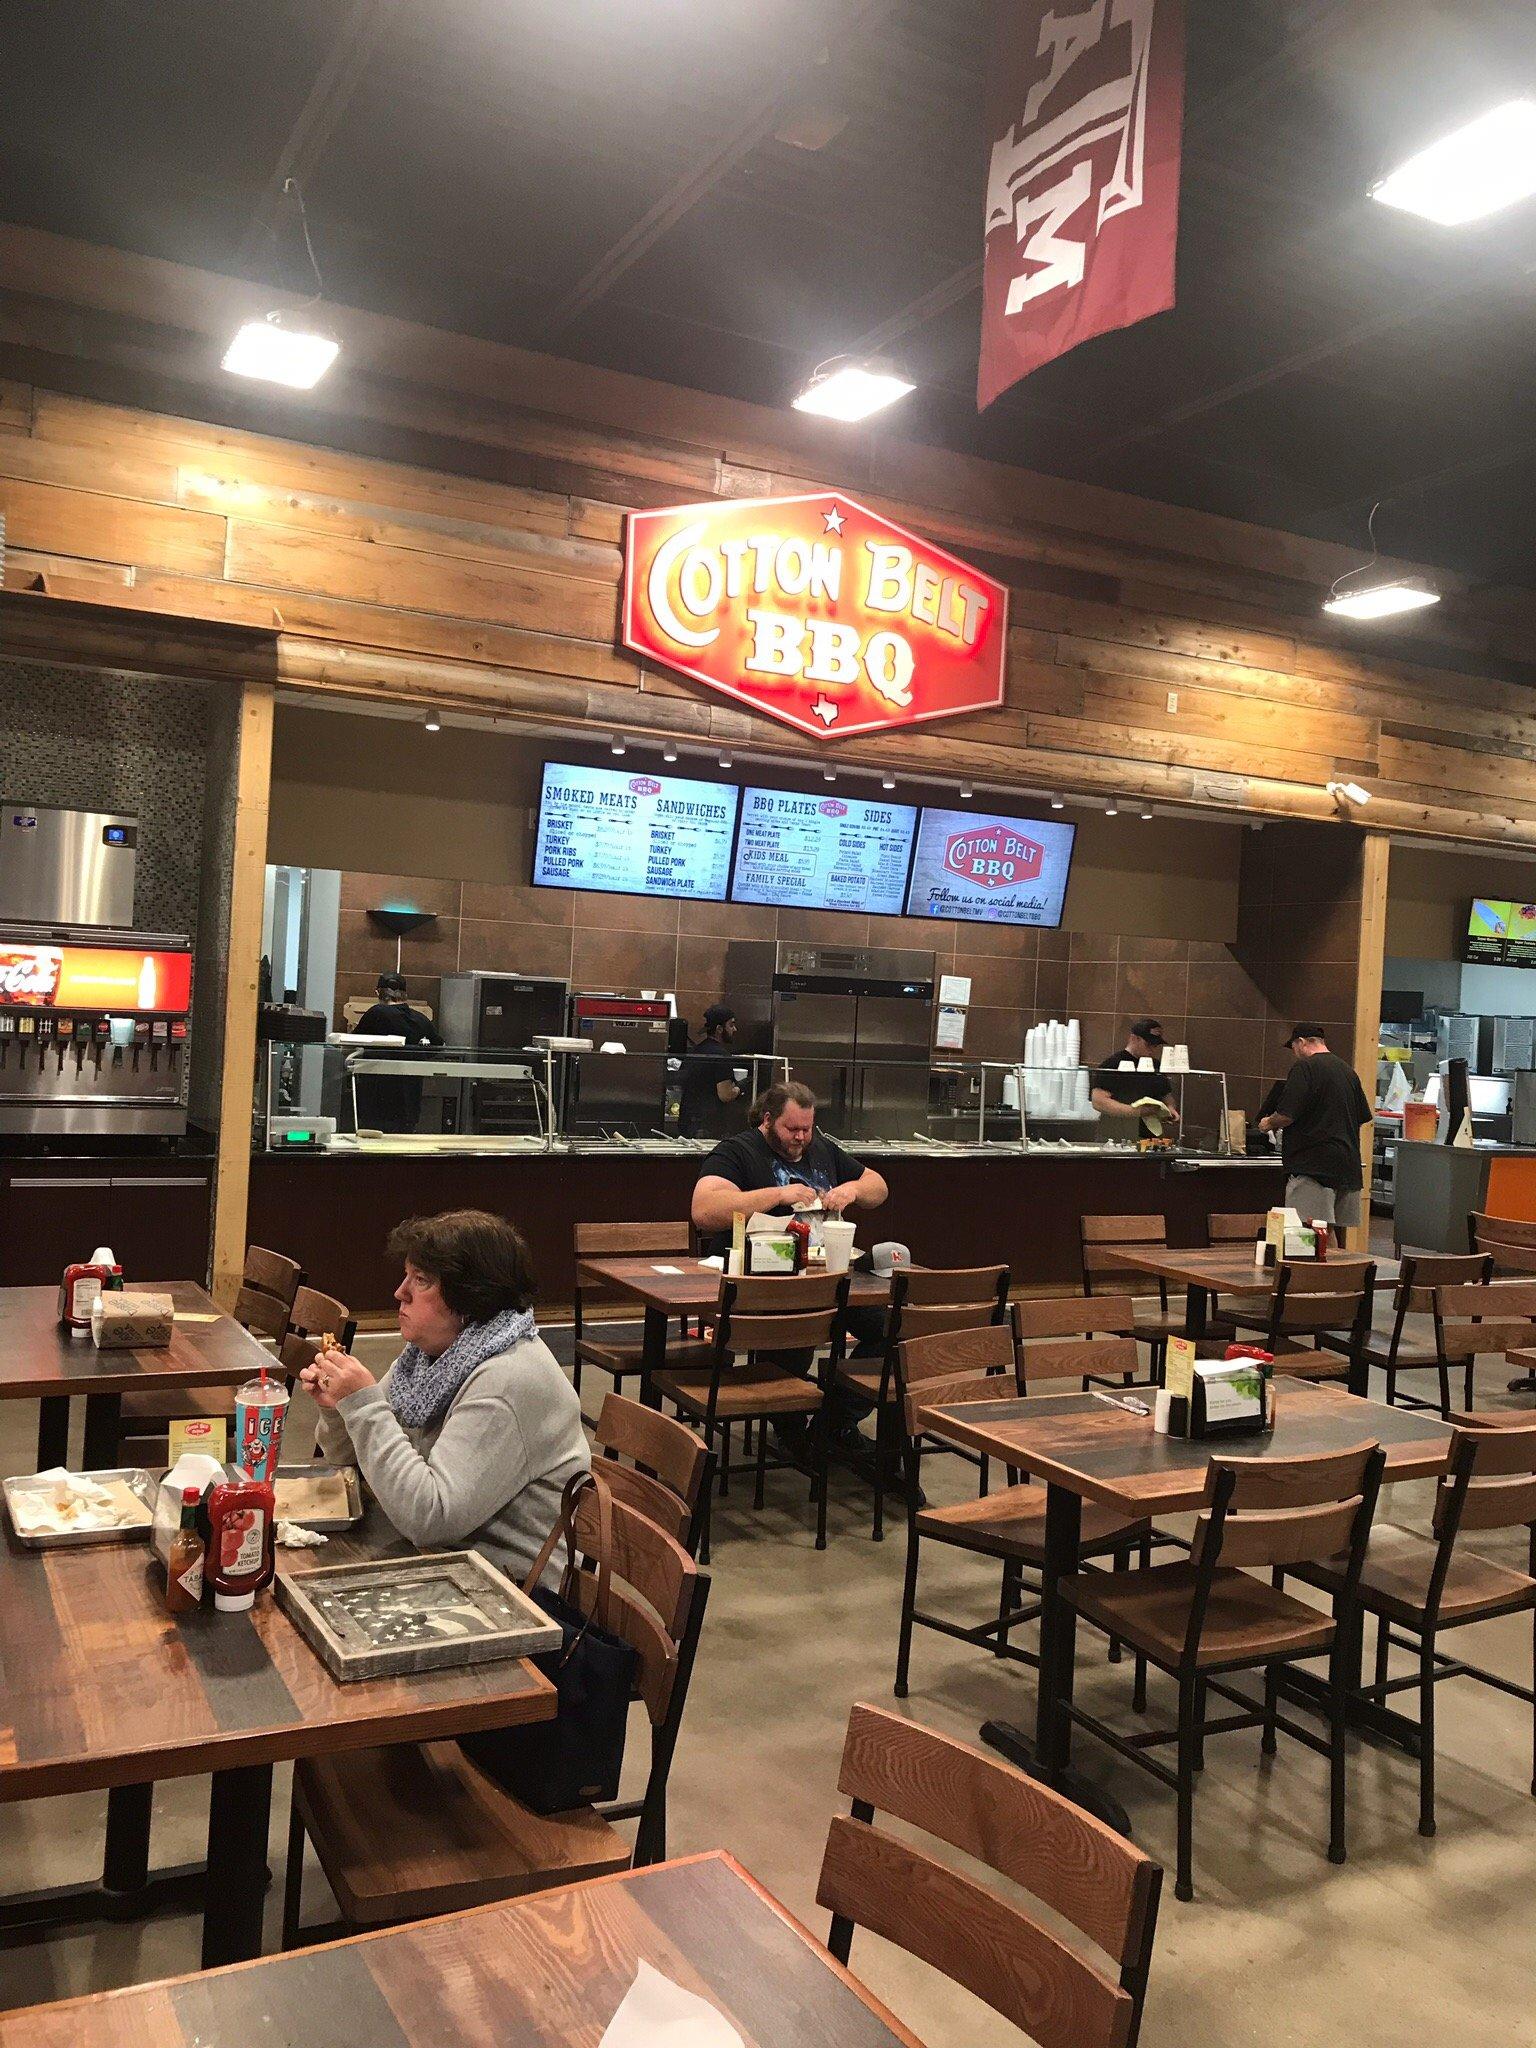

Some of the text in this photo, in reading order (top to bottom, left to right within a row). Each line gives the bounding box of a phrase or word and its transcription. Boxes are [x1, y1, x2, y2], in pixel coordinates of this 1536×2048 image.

[648, 519, 988, 648] COTTON BELT
[745, 608, 916, 708] BBQ
[545, 785, 594, 804] SMOKED
[599, 792, 637, 809] MEATS
[656, 799, 727, 819] SANDWICHES
[753, 796, 817, 815] BBQ PLATES
[864, 809, 892, 824] SIDES
[547, 819, 573, 830] BRISKET
[650, 830, 675, 840] BRISKET
[755, 829, 767, 837] MEAT
[545, 834, 570, 845] TURKEY
[839, 839, 866, 848] COLD SIDES
[544, 845, 576, 857] PORK RIBS
[649, 845, 672, 855] TURKEY
[879, 843, 903, 853] HOT SIDES
[948, 836, 1037, 869] COTTON BELT
[543, 856, 566, 867] PULLED
[567, 858, 584, 868] PORK
[647, 855, 686, 867] PULLED PORK
[748, 850, 789, 862] KIDS MEAL
[542, 866, 570, 877] SAUSAGE
[646, 866, 673, 876] SAUSAGE
[970, 858, 1015, 880] BBQ
[645, 876, 695, 888] SANDWICH PLATE
[746, 873, 806, 887] FAMILY SPECIAL
[830, 874, 866, 884] BAKED POTATO
[927, 887, 960, 902] Follow
[975, 897, 987, 905] on
[988, 894, 1016, 908] social
[1016, 896, 1048, 910] media!
[240, 1550, 260, 1560] TOMATO
[237, 1558, 260, 1567] KETCHUP
